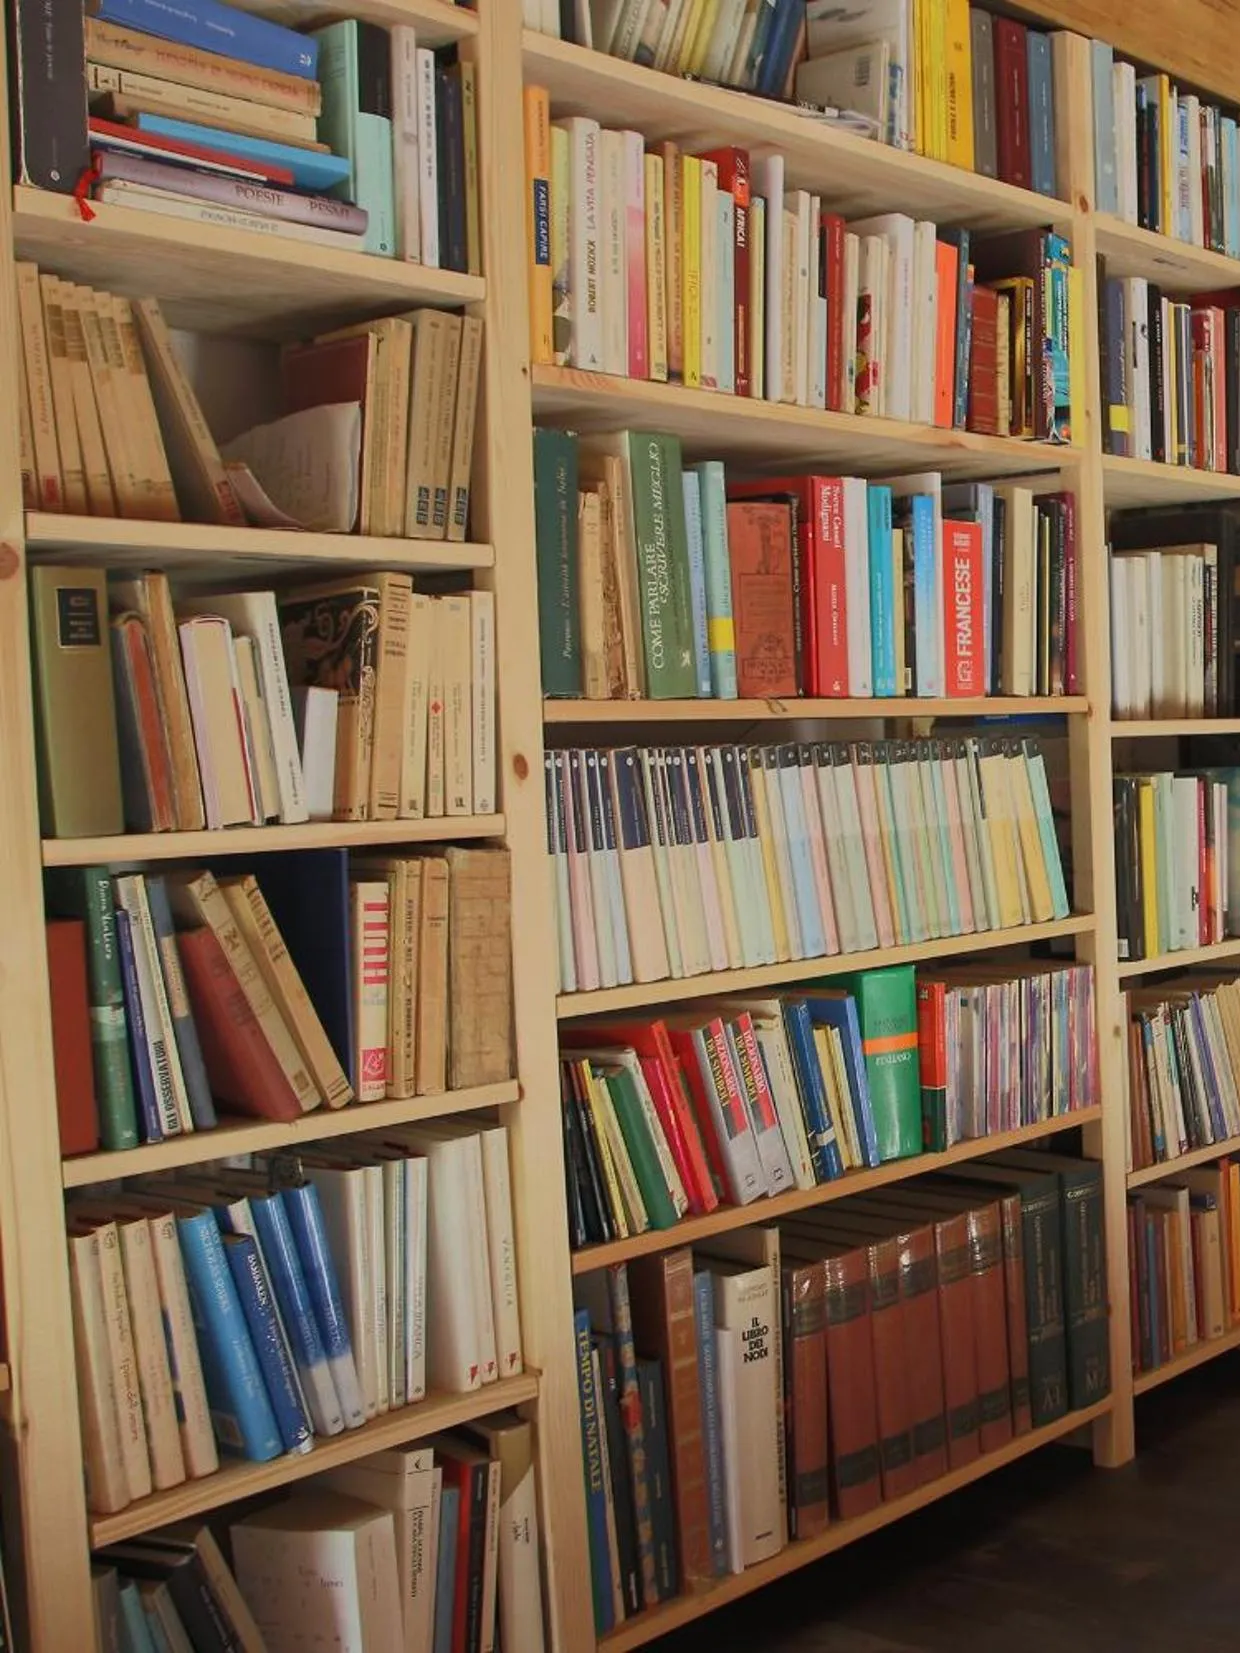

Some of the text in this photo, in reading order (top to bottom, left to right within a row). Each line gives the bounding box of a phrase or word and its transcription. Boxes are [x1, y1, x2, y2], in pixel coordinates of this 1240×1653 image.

[235, 185, 285, 206] POESIE
[539, 184, 550, 259] FARSI CAPIRE
[587, 278, 597, 314] ROBERT
[649, 442, 664, 511] MEGLIO
[820, 486, 832, 543] Modignani
[652, 513, 669, 597] SCRIVERE
[644, 543, 665, 670] COME PARLARE
[954, 558, 973, 657] FRANCESE
[706, 1038, 731, 1107] DEI SIMBOLI
[713, 1033, 738, 1098] DIZIONARIO
[739, 1055, 758, 1104] SIMBOLI
[743, 1031, 767, 1095] DIZIONARIO
[742, 1326, 769, 1342] LIBRO
[748, 1338, 764, 1351] DEI
[751, 1317, 760, 1329] IL
[743, 1348, 769, 1364] NODI
[578, 1330, 601, 1494] TEMPO DI NATALE
